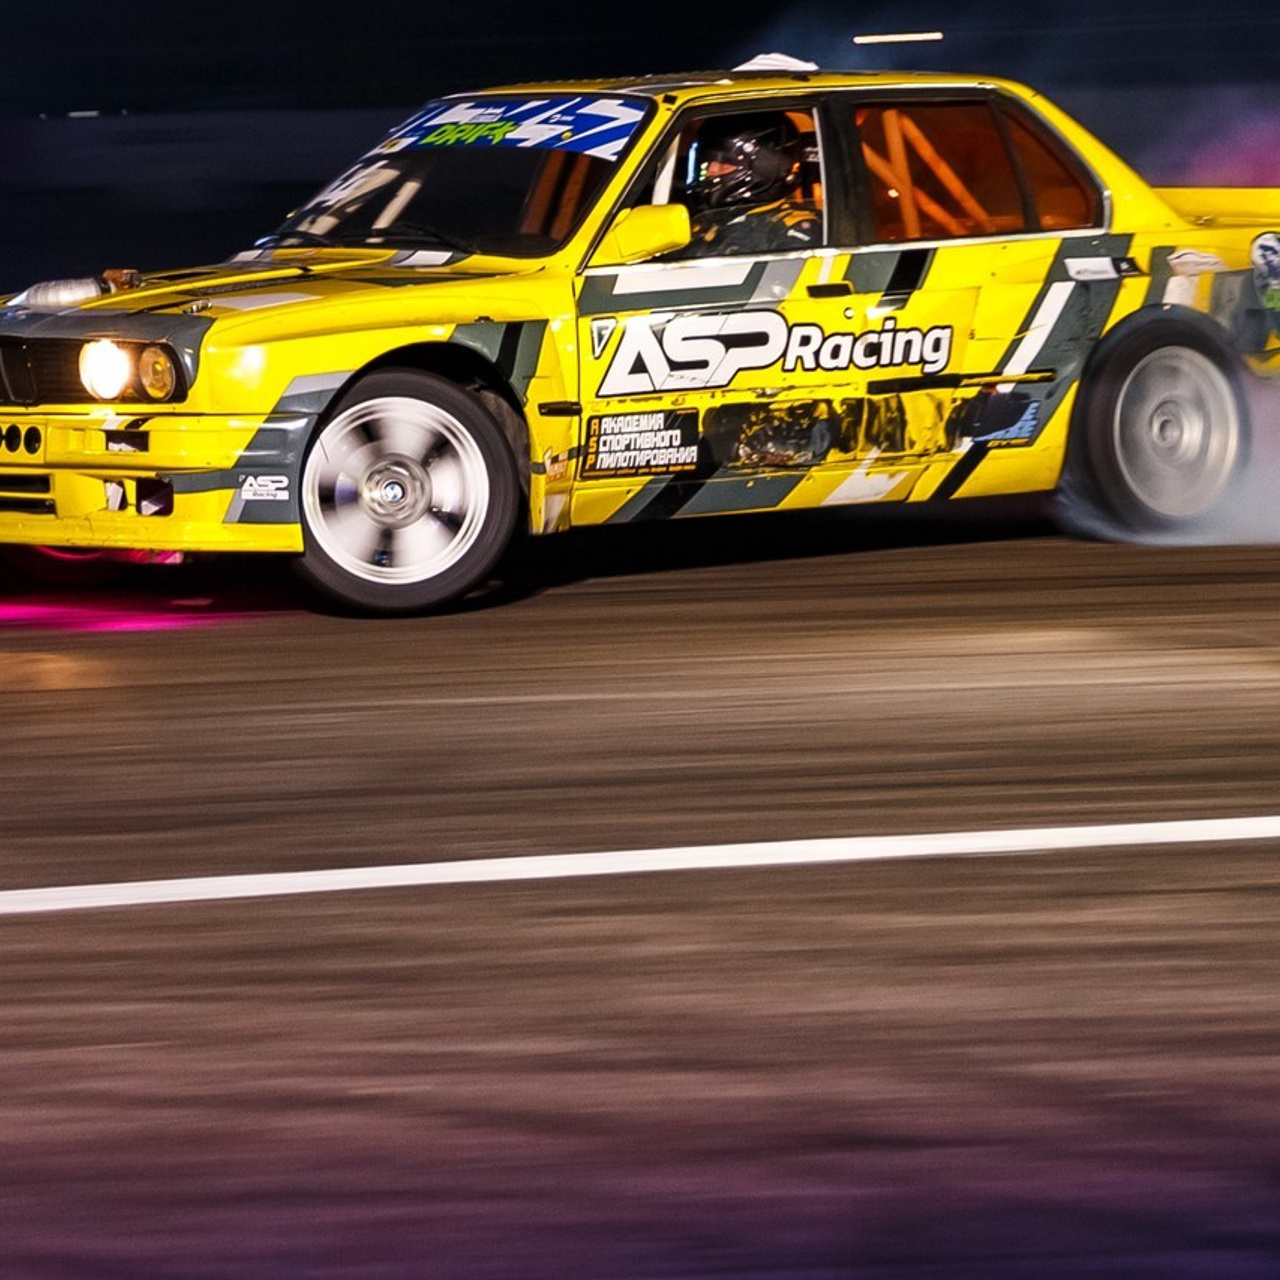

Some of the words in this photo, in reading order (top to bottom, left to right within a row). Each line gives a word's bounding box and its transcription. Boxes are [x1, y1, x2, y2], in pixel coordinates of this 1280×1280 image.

[418, 121, 518, 145] DRIFT
[596, 311, 788, 397] ASP
[784, 320, 952, 373] Racing
[601, 412, 665, 434] АКАДЕМИЯ
[598, 429, 681, 452] СПОРТИВНОГО
[595, 445, 698, 470] ПИЛОТИРОВАНИЯ
[241, 475, 289, 491] ASP
